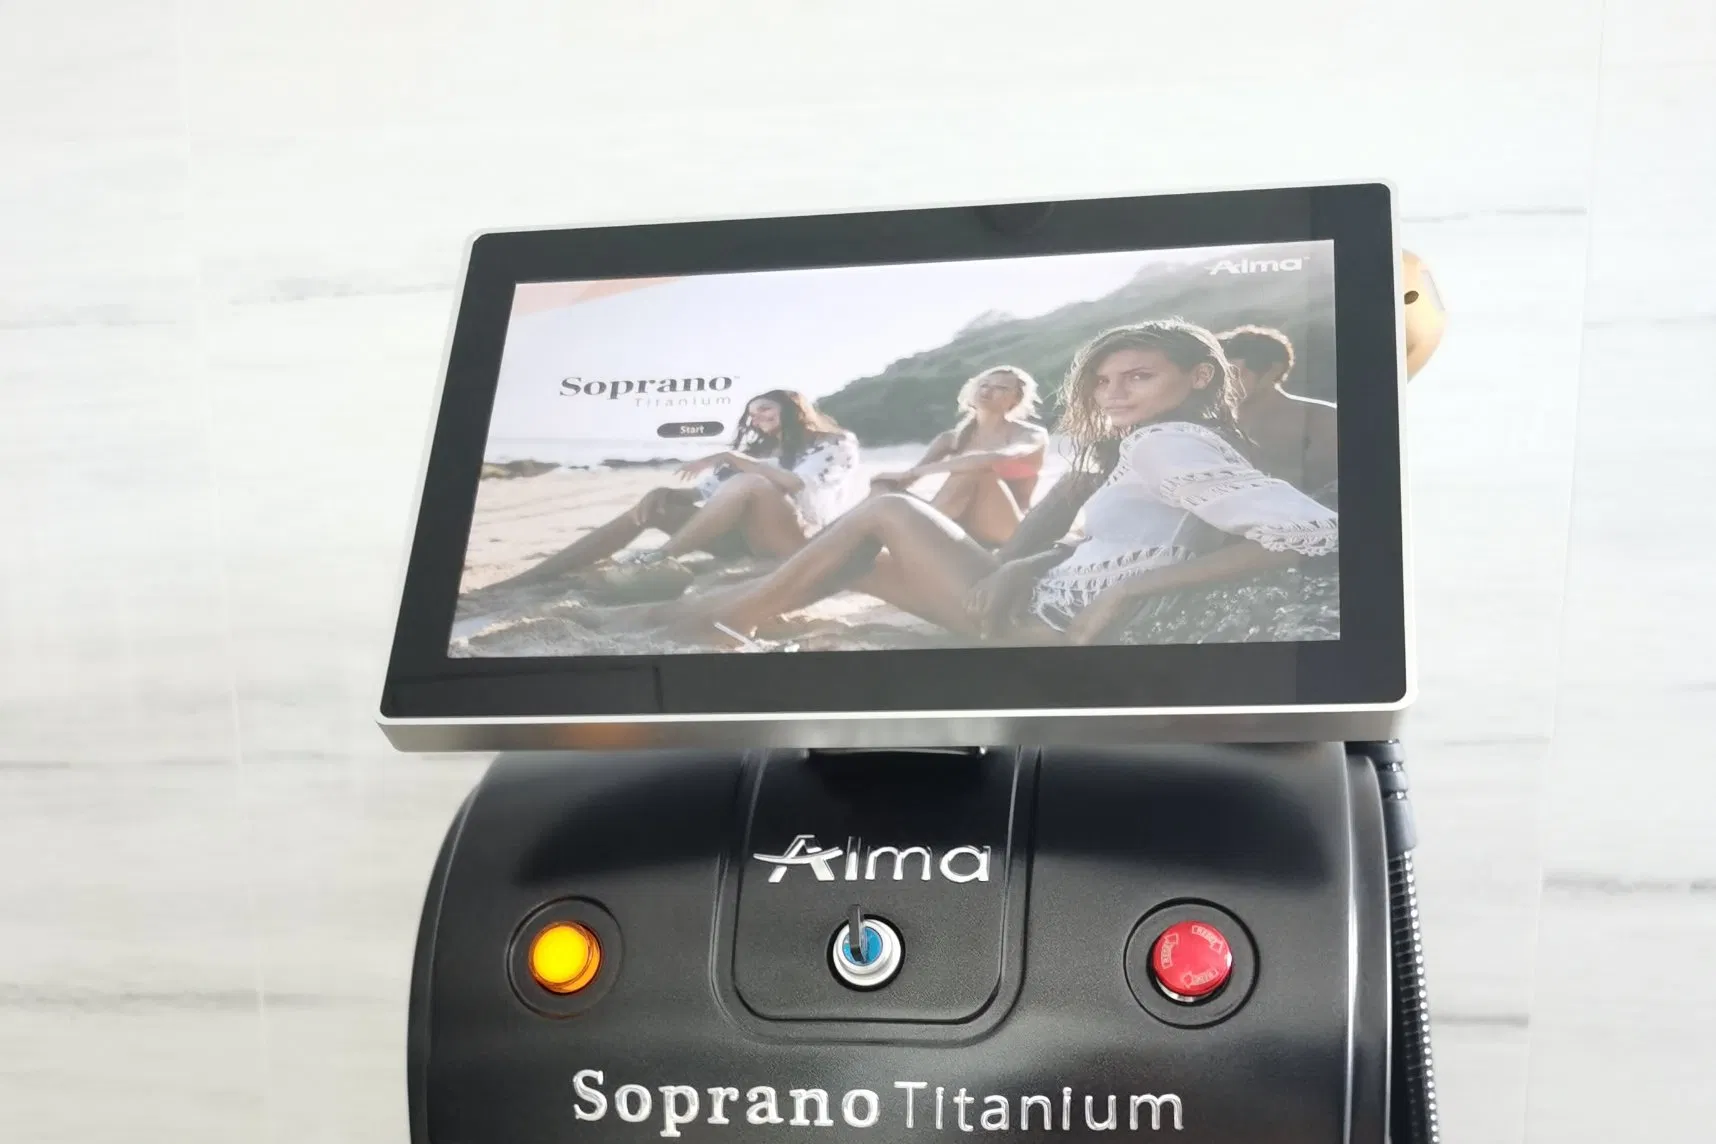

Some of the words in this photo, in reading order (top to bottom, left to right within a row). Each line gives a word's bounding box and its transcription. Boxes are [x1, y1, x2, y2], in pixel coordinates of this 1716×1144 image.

[1205, 257, 1302, 276] Alma
[559, 376, 733, 400] Soprano
[680, 425, 705, 435] Start
[753, 834, 991, 883] Alma
[572, 1069, 882, 1138] Soprano
[894, 1081, 1184, 1133] Titanium
